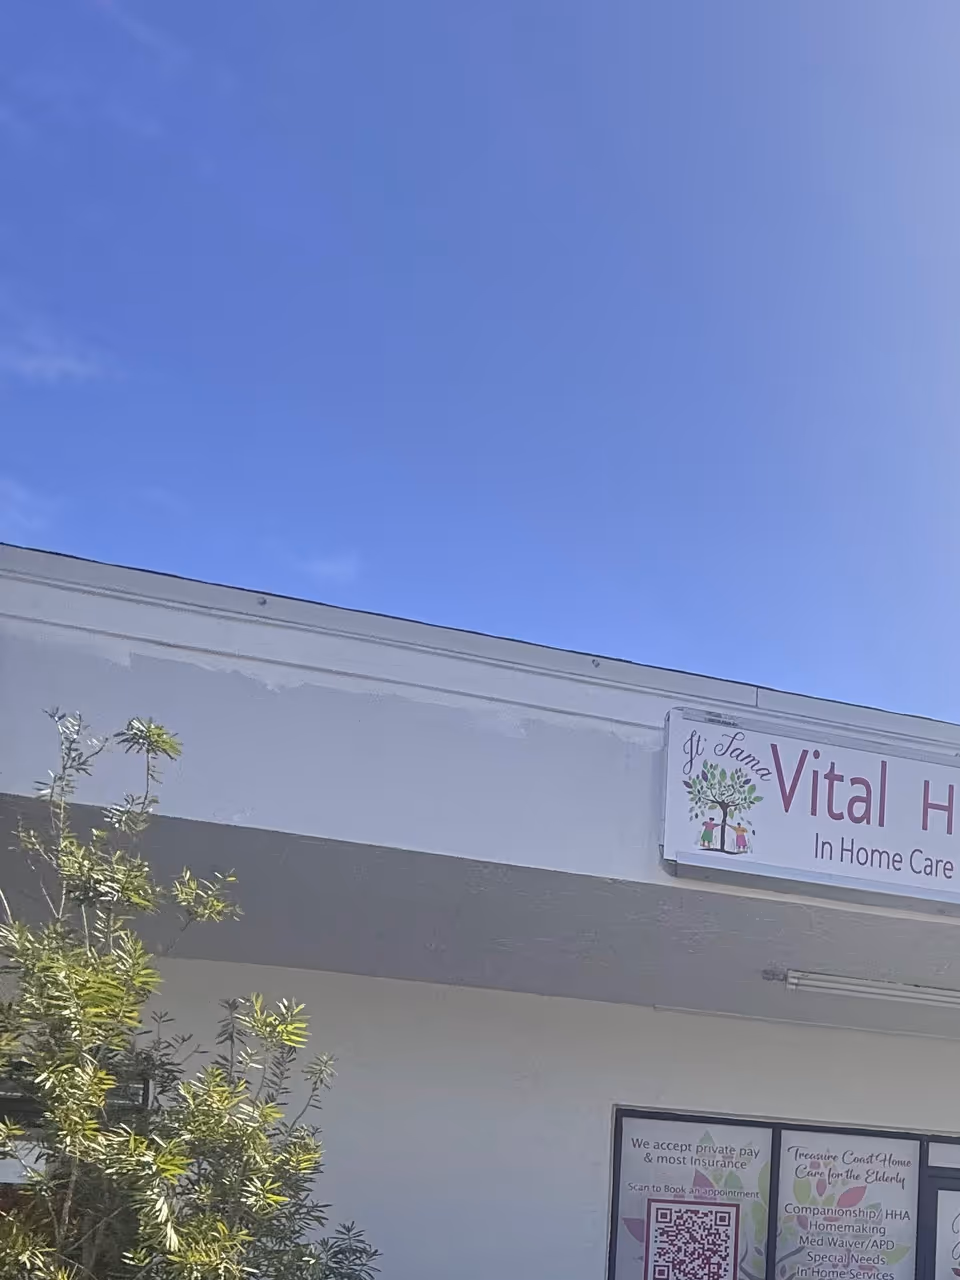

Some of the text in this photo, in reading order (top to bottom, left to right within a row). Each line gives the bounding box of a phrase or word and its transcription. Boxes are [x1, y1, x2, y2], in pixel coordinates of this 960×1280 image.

[770, 743, 888, 827] Vital
[814, 832, 833, 861] In
[840, 836, 903, 872] Home
[909, 848, 954, 879] Care
[631, 1137, 761, 1160] We accept private pay
[787, 1145, 913, 1168] Treasure Coast Home
[643, 1152, 748, 1170] & most Insurance
[794, 1164, 906, 1191] Care for the Elderly
[628, 1182, 761, 1200] Scan to Book an appointment
[784, 1202, 911, 1221] Companionship/ HHA
[809, 1220, 887, 1237] Homemaking
[798, 1235, 895, 1251] Med Waiver/APD
[807, 1251, 886, 1266] Special Needs
[796, 1266, 808, 1277] In
[811, 1267, 847, 1280] Home
